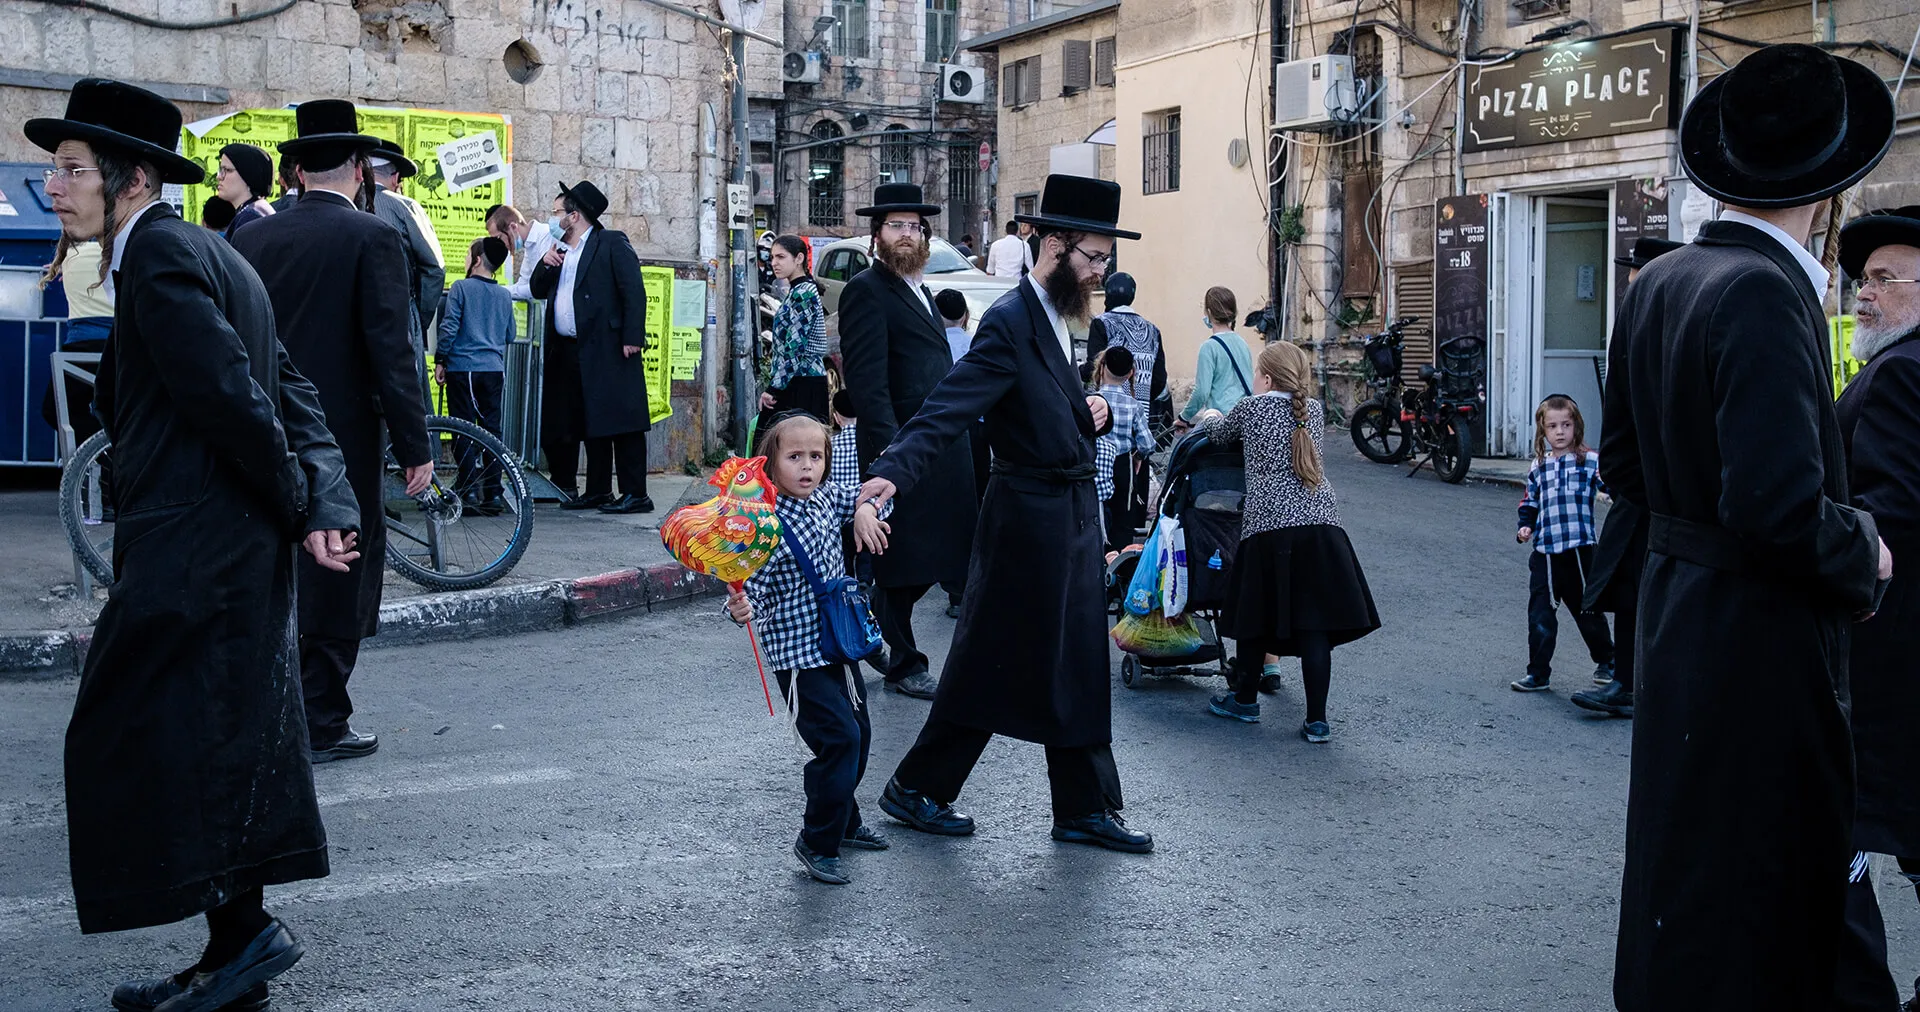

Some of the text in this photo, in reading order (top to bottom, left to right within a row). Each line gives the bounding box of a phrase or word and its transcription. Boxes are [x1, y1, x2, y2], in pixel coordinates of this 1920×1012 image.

[1479, 66, 1651, 120] PIZZA PLACE
[201, 136, 229, 146] בפיקוח
[456, 140, 480, 153] מכירת
[460, 151, 482, 163] עופות
[461, 160, 487, 174] לכפרות
[452, 205, 488, 221] מחיר
[1646, 214, 1668, 224] פסטה
[1460, 251, 1471, 267] 18
[1437, 306, 1485, 332] PIZZA
[502, 453, 515, 467] CST
[512, 467, 527, 500] PATROL
[724, 518, 751, 532] Good
